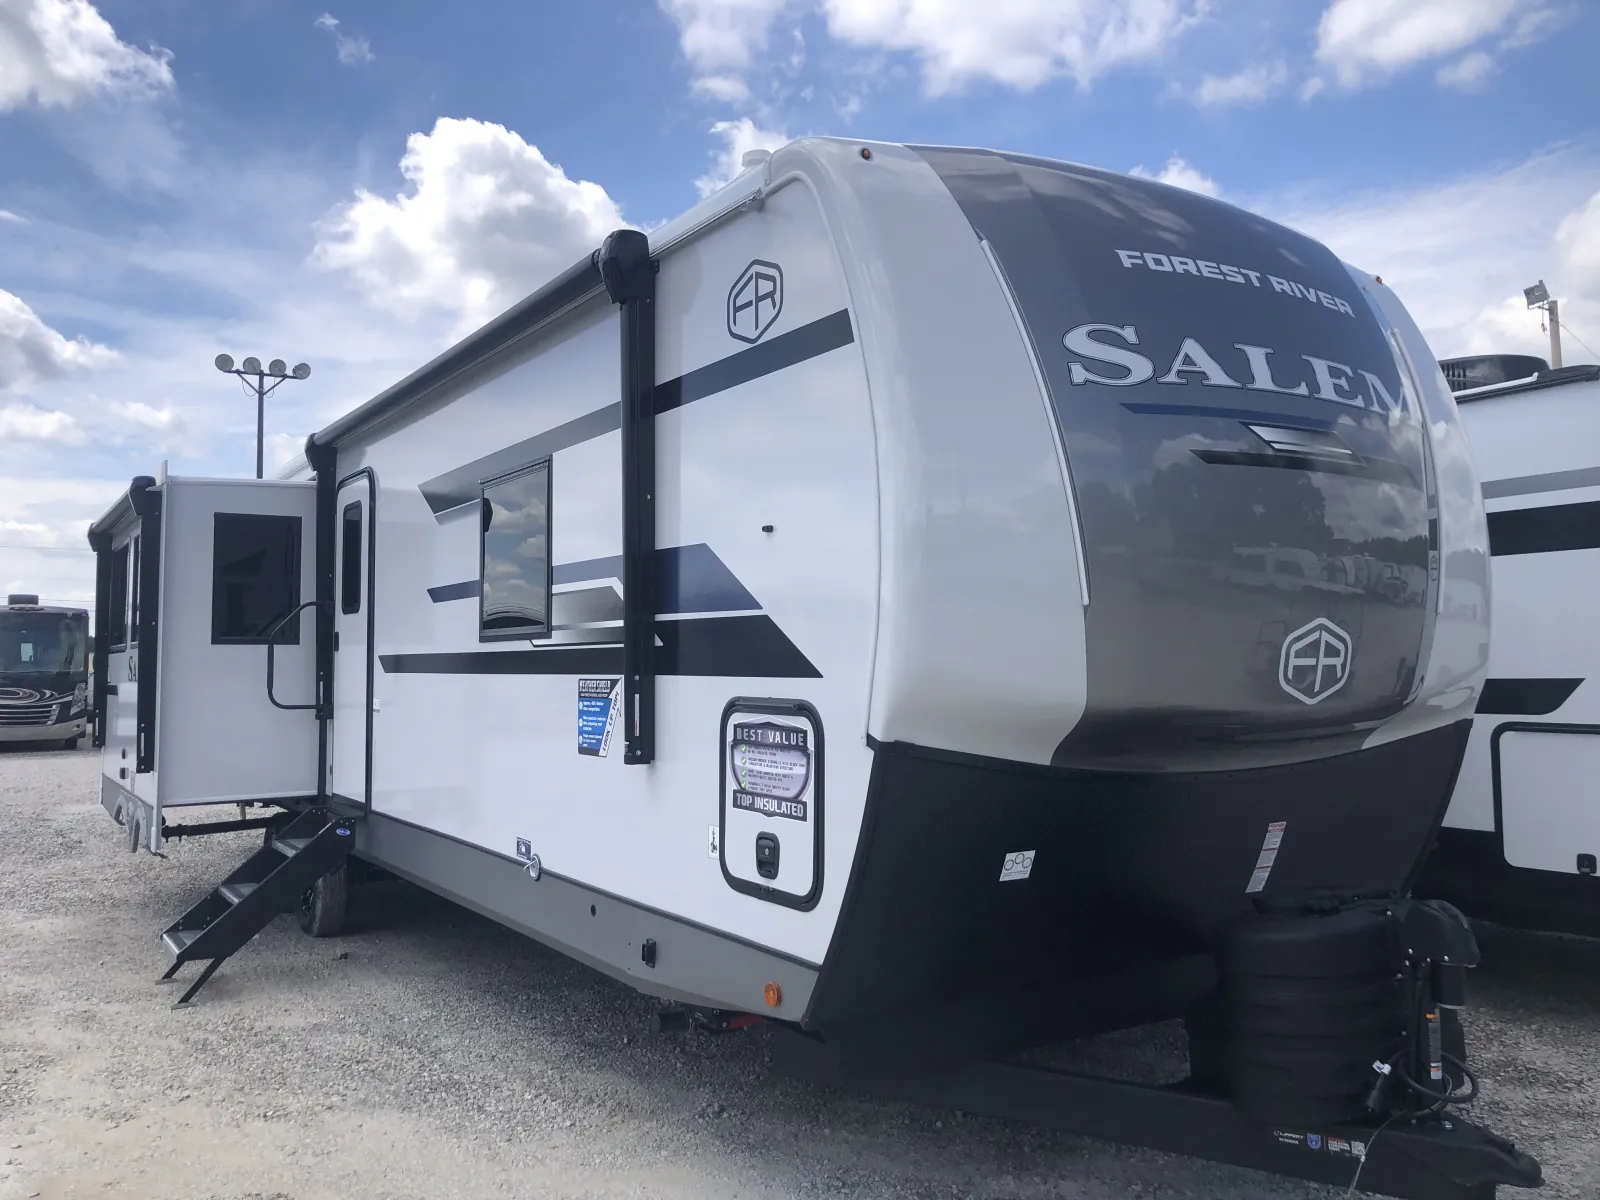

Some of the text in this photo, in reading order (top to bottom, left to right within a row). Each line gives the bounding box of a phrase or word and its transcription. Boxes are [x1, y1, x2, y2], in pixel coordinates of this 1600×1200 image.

[1114, 249, 1356, 318] FOREST RIVER
[1062, 322, 1412, 420] SALEM
[602, 691, 620, 752] LOOK UP TOP!
[736, 727, 804, 746] BEST VALUE
[736, 792, 804, 817] TOP INSULATED
